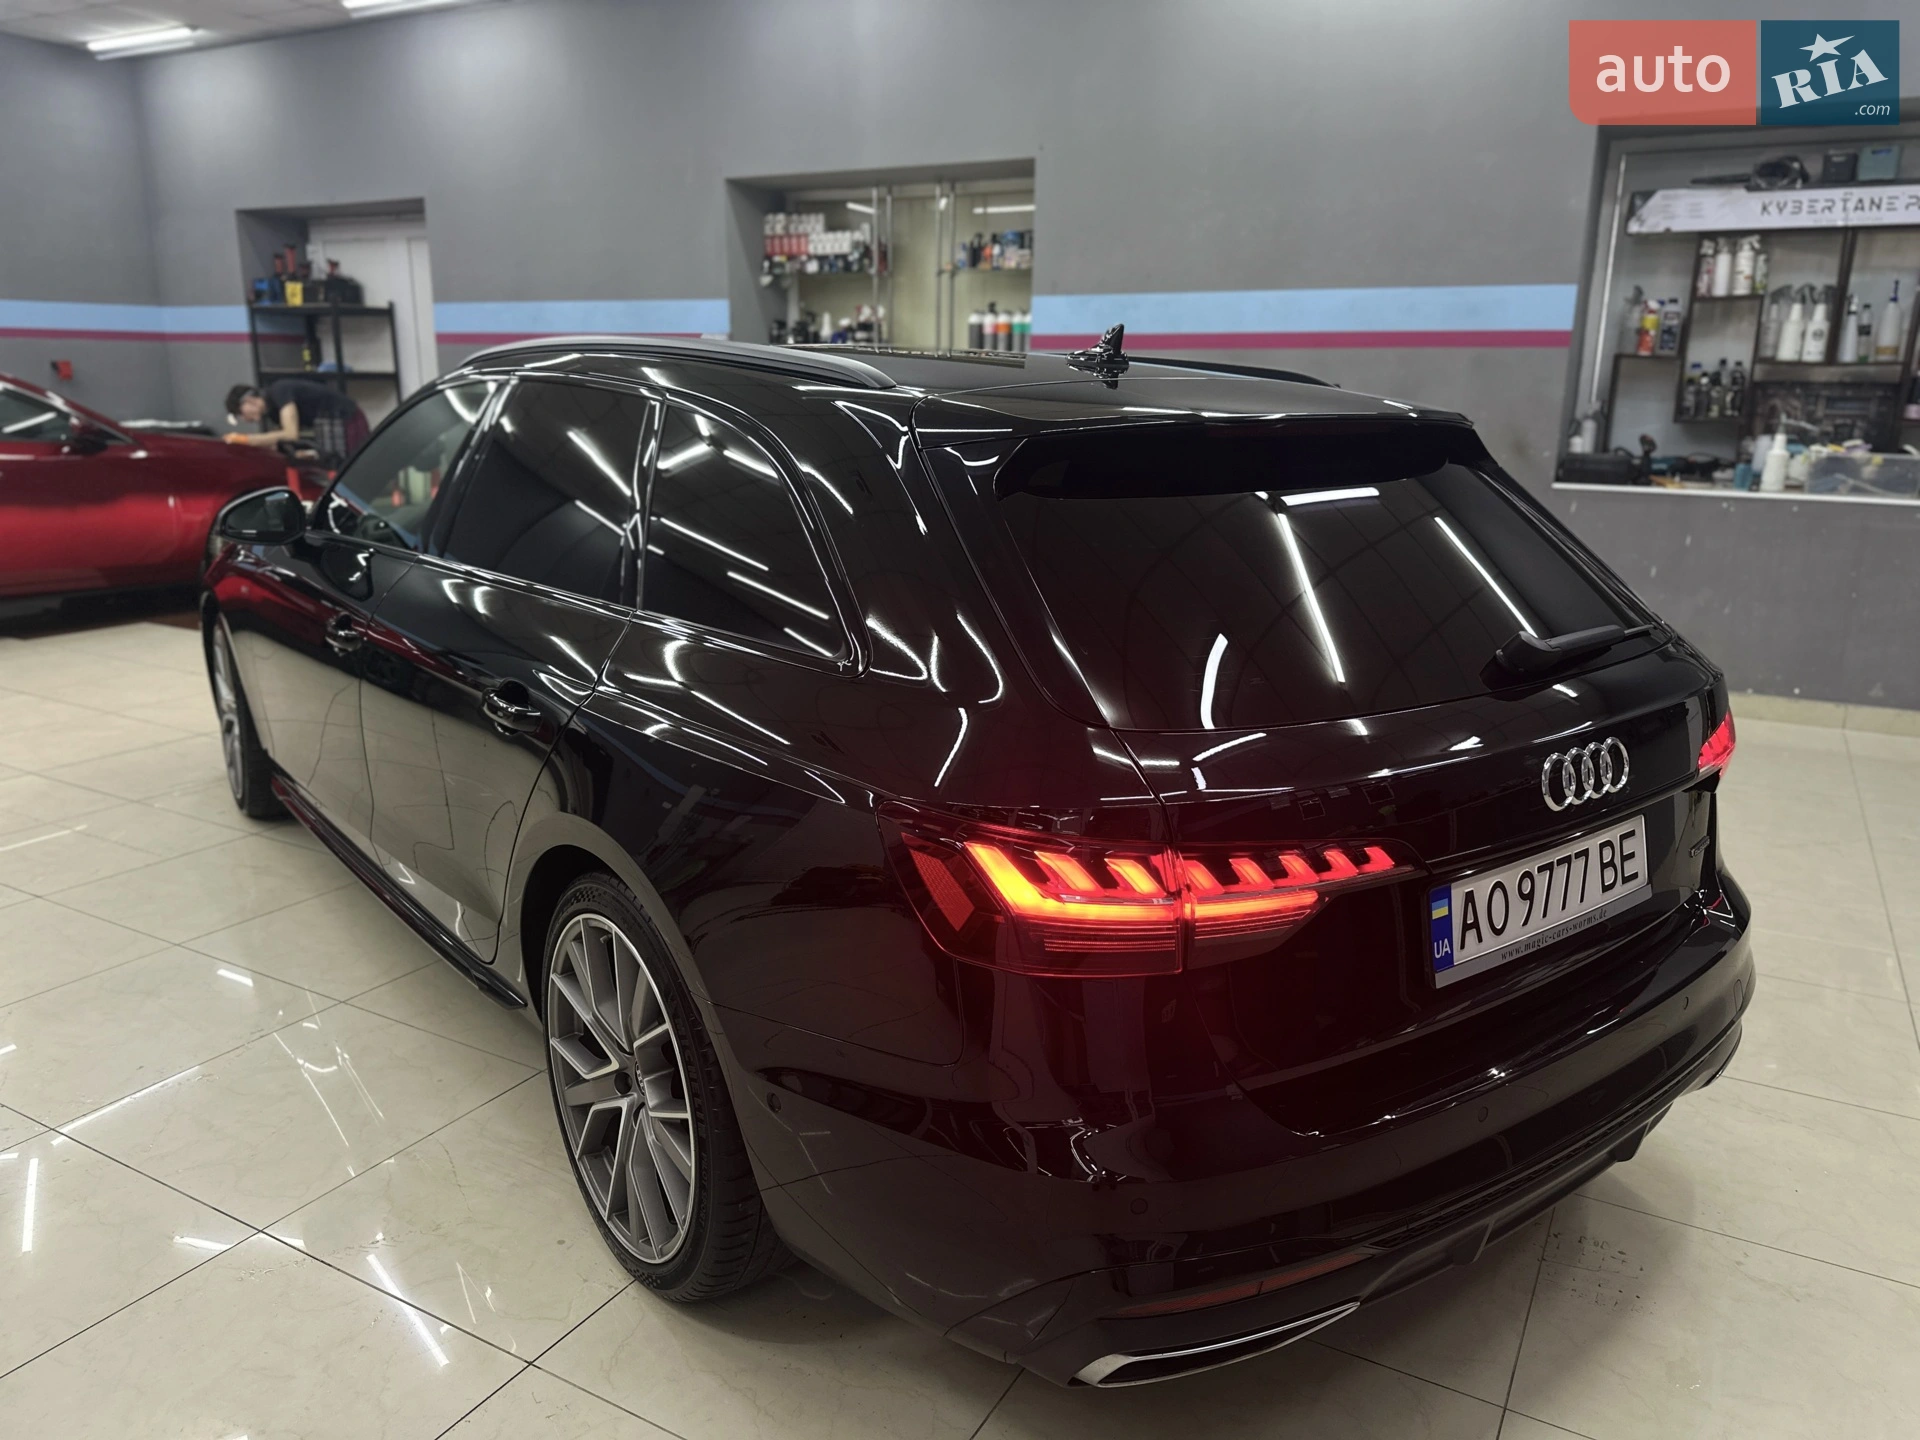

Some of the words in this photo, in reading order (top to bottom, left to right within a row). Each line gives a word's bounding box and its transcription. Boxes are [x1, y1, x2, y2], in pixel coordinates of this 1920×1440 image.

[1459, 880, 1510, 951] AO
[1516, 847, 1590, 928] 9777
[1598, 829, 1640, 894] BE
[1434, 938, 1452, 959] UA
[1501, 908, 1608, 961] www.magic-cars-worms.de
[674, 1017, 707, 1140] MICHELIN
